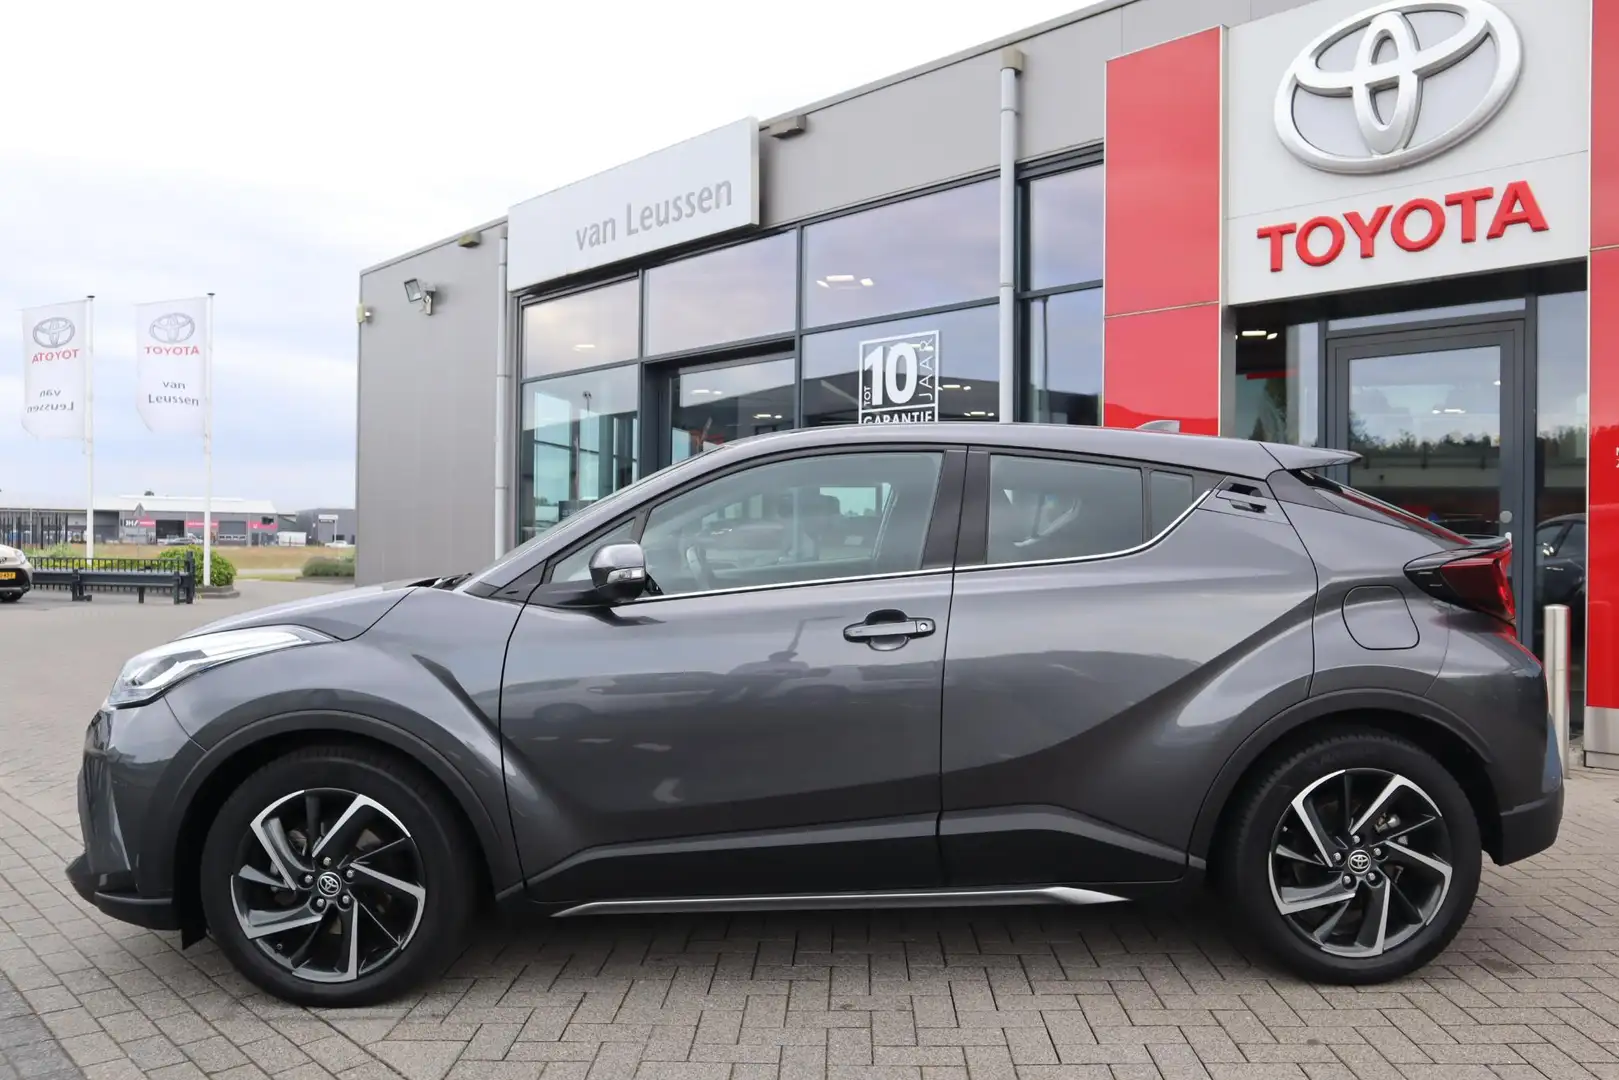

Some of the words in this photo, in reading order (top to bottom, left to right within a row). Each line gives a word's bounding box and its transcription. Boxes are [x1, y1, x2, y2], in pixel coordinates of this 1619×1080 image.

[576, 217, 616, 251] van
[626, 180, 732, 236] Leussen
[1257, 180, 1549, 272] TOYOTA
[145, 346, 200, 356] TOYOTA
[919, 336, 934, 401] JAAR
[162, 380, 186, 390] van
[864, 342, 918, 406] 10
[148, 393, 199, 407] Leussen
[863, 386, 872, 407] TOT
